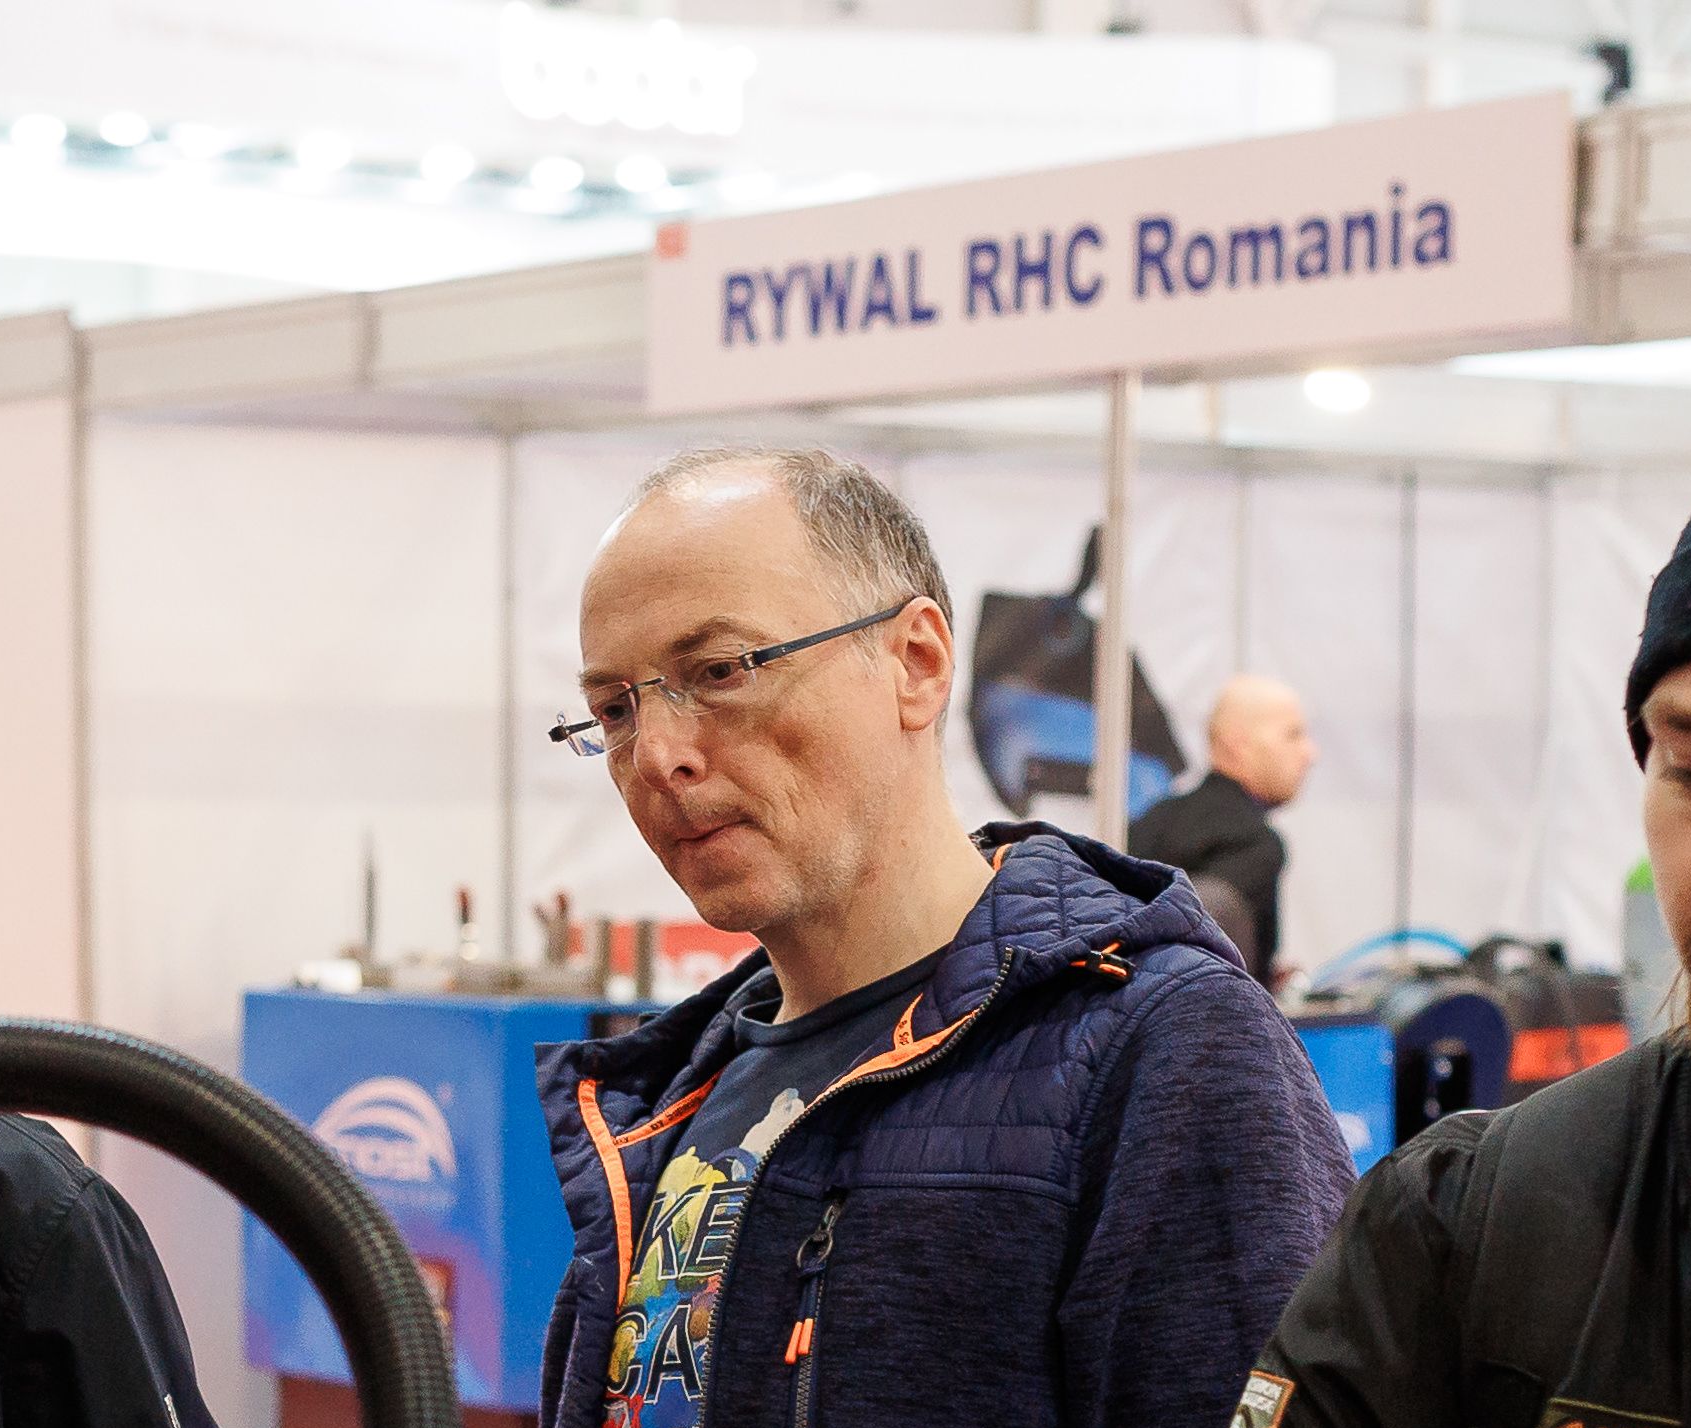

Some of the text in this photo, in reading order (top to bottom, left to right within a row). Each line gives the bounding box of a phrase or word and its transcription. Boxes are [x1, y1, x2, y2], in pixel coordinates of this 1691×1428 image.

[721, 181, 1456, 348] RYWAL RHC Romania
